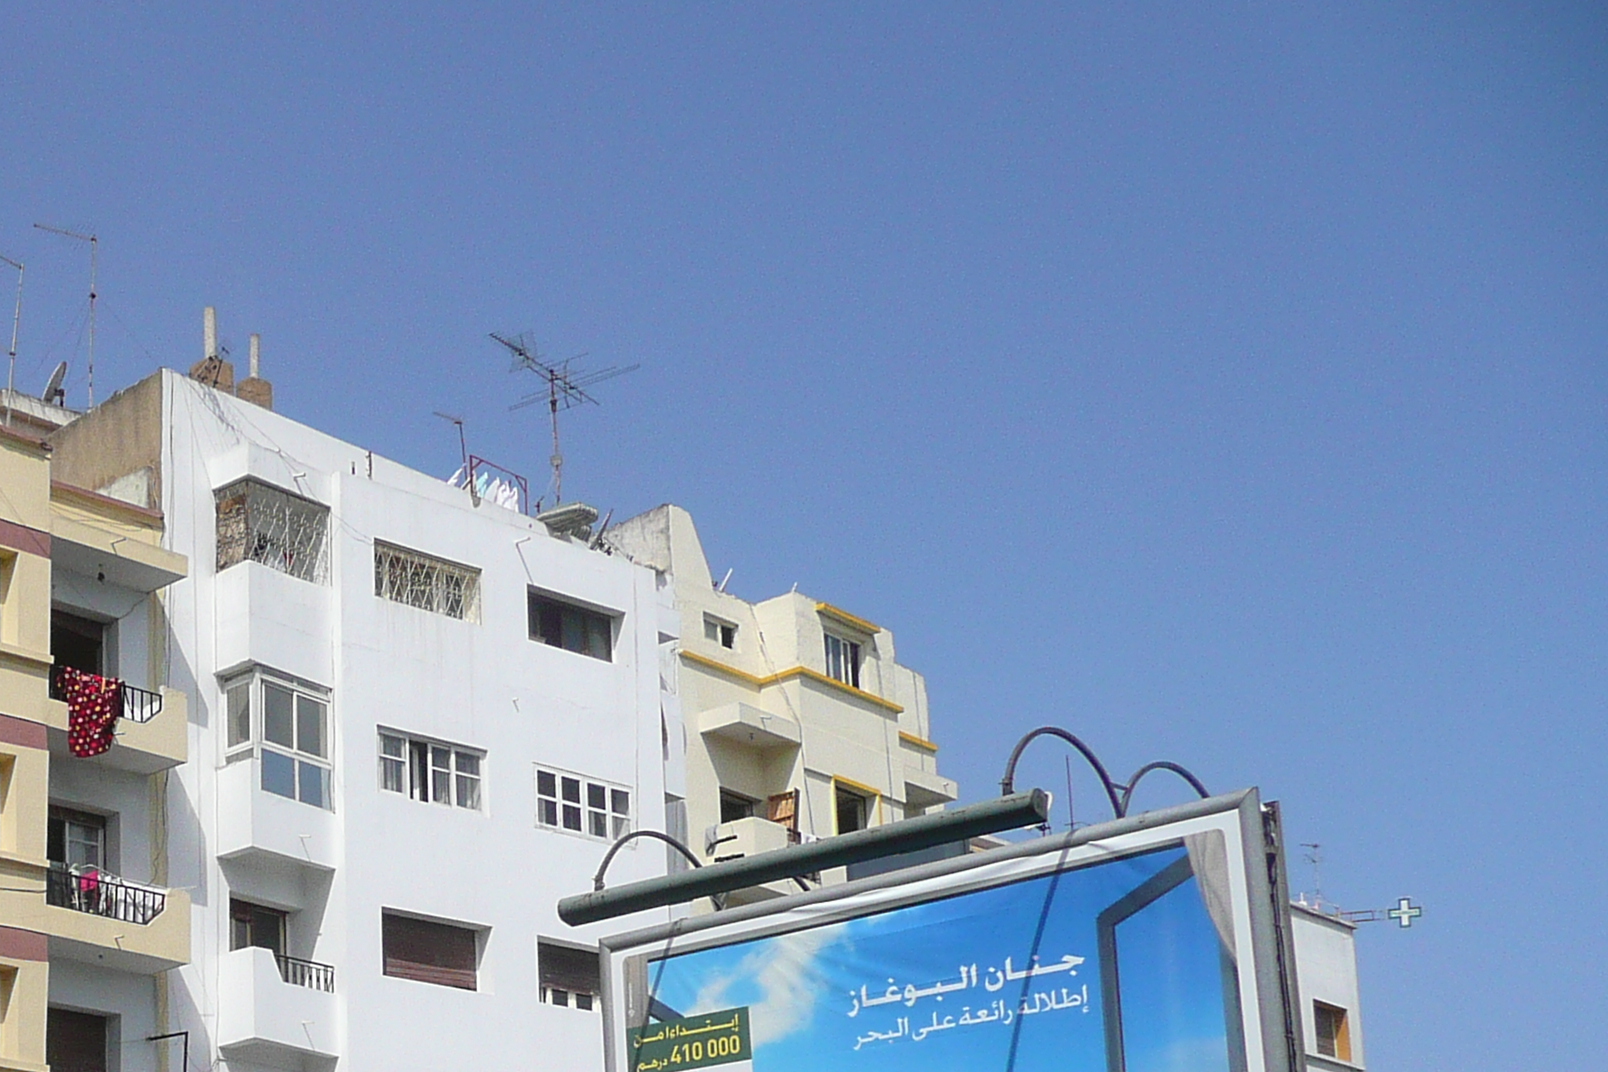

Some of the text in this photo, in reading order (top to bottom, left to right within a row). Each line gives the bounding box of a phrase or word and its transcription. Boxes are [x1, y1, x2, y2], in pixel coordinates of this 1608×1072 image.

[847, 954, 1085, 1017] جنان البوغاز
[671, 1042, 702, 1063] 410
[707, 1035, 741, 1058] 000
[853, 985, 1089, 1050] إطلالة رائعة على البحر
